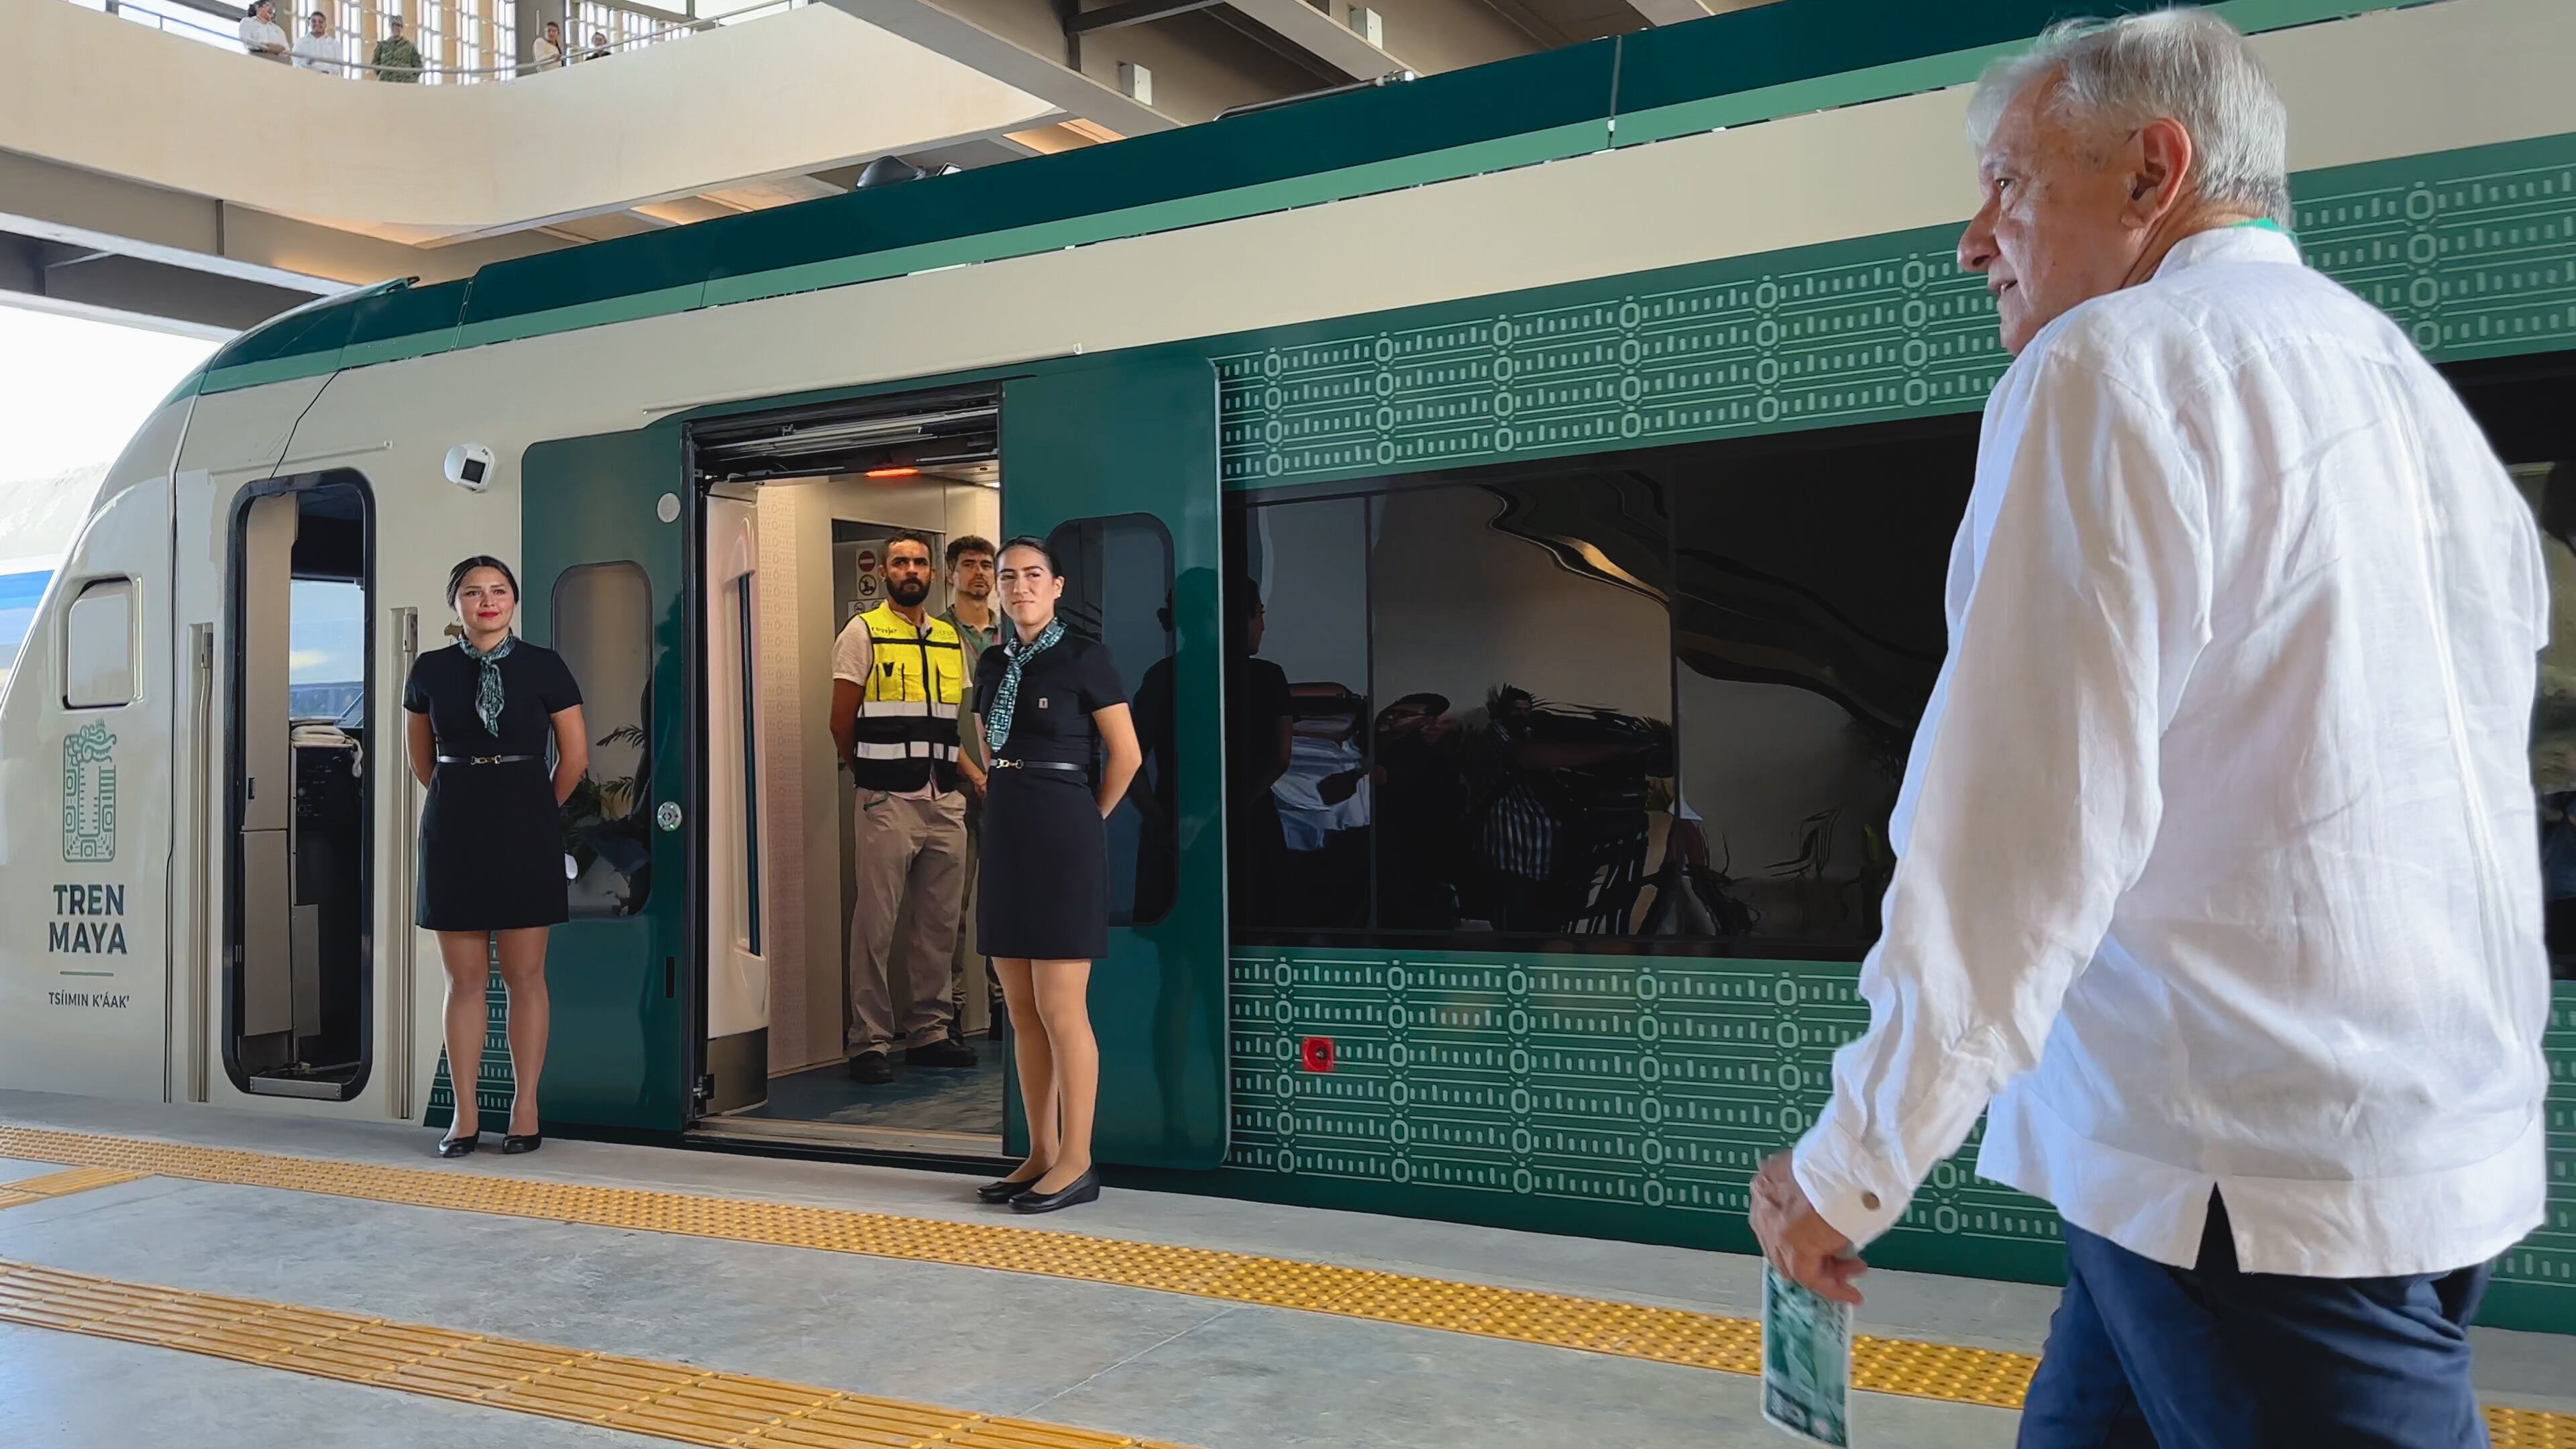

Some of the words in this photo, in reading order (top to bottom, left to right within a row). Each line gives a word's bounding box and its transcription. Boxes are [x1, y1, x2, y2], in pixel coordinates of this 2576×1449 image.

[53, 884, 125, 916] TREN
[49, 922, 127, 955] MAYA
[48, 989, 89, 1007] TSÍIMIN
